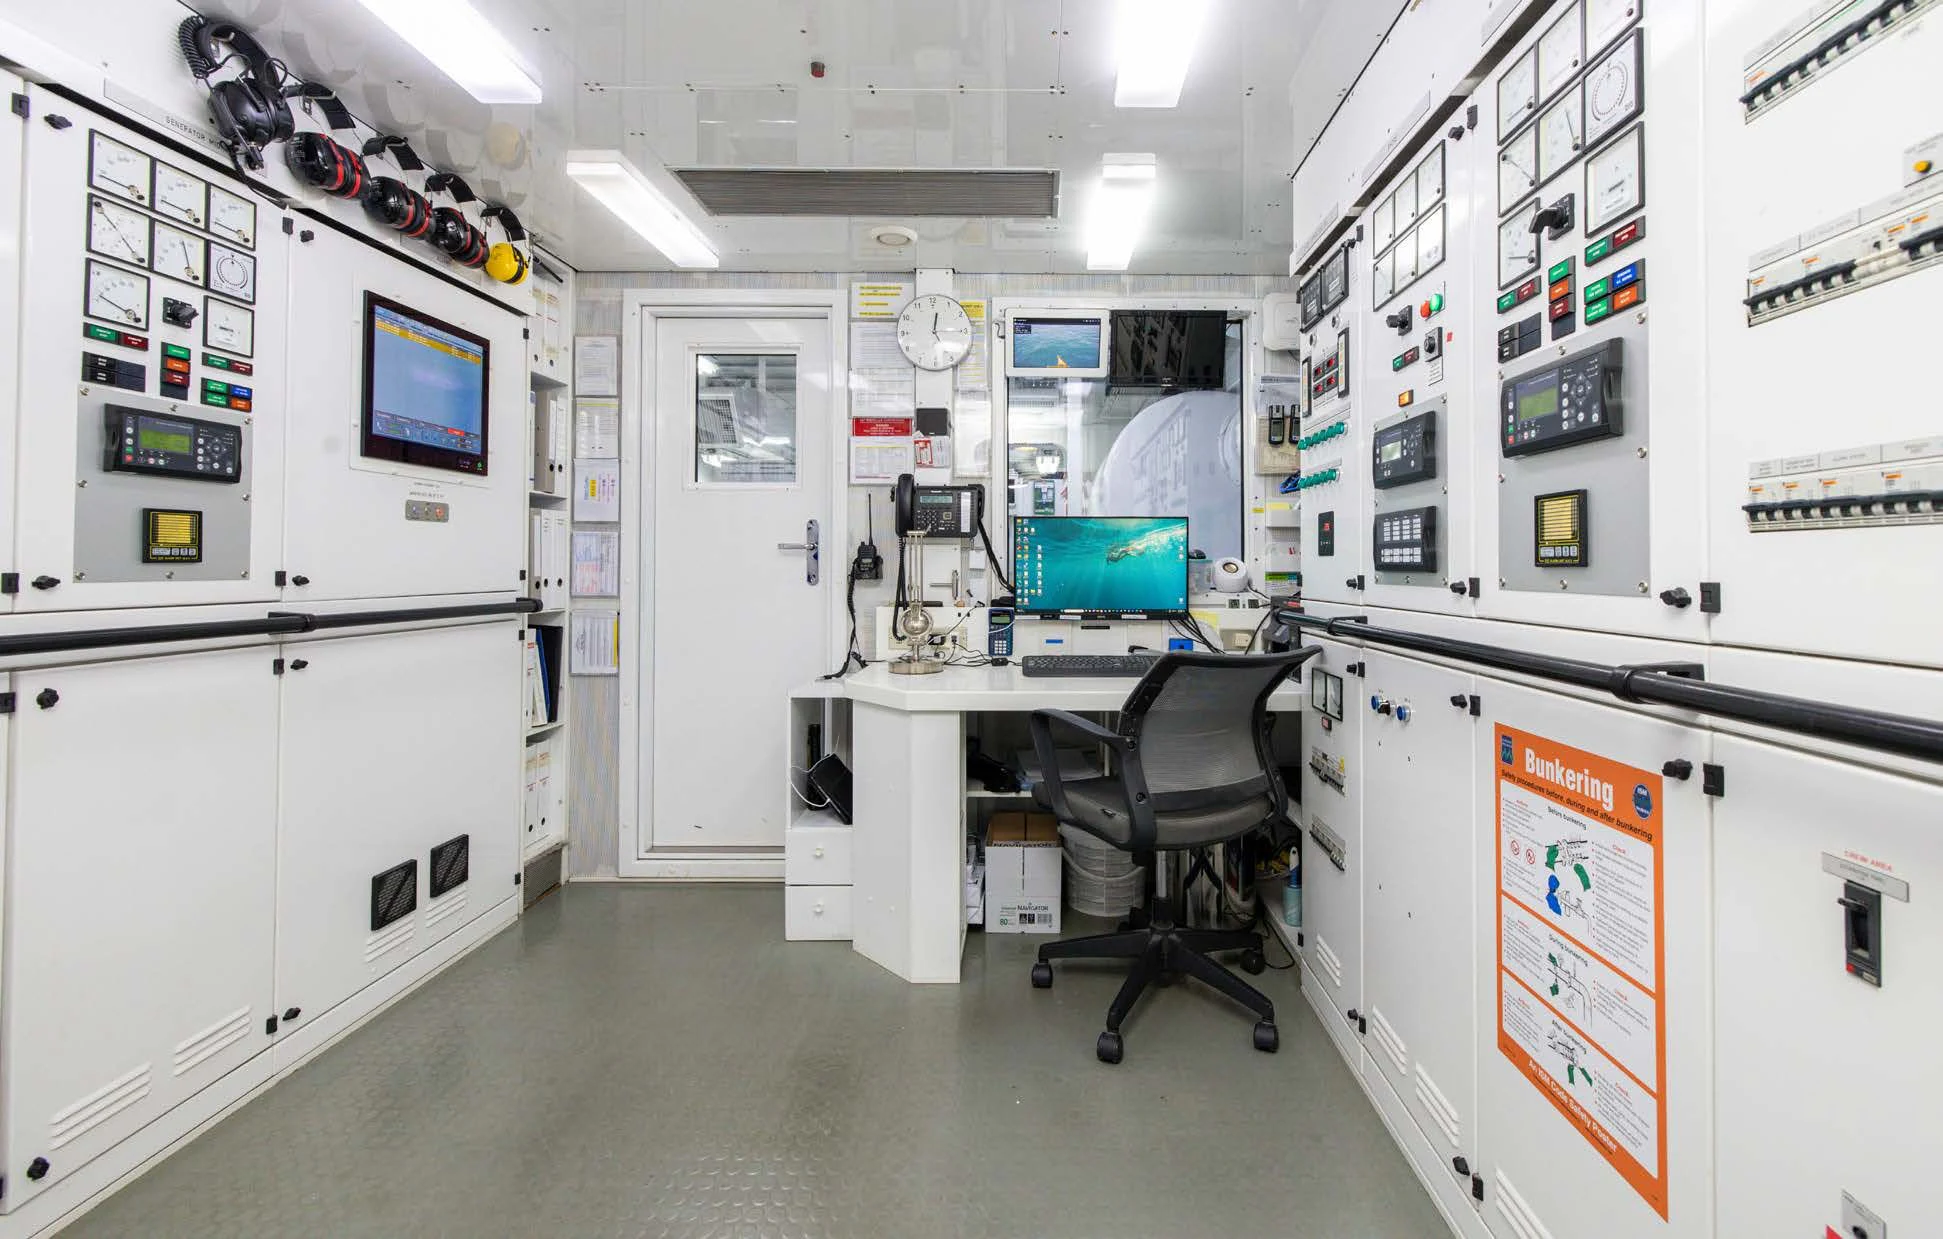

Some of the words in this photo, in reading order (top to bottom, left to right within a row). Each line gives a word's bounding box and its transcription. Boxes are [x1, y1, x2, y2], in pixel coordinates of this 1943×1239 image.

[1501, 768, 1516, 782] Safety
[1516, 777, 1545, 794] procedures
[1566, 797, 1586, 813] during
[1586, 805, 1599, 817] and
[1600, 812, 1616, 824] after
[1616, 818, 1653, 842] bunkering
[1524, 747, 1614, 812] Bunkering
[1568, 1098, 1592, 1128] Safety
[1592, 1121, 1617, 1153] Poster
